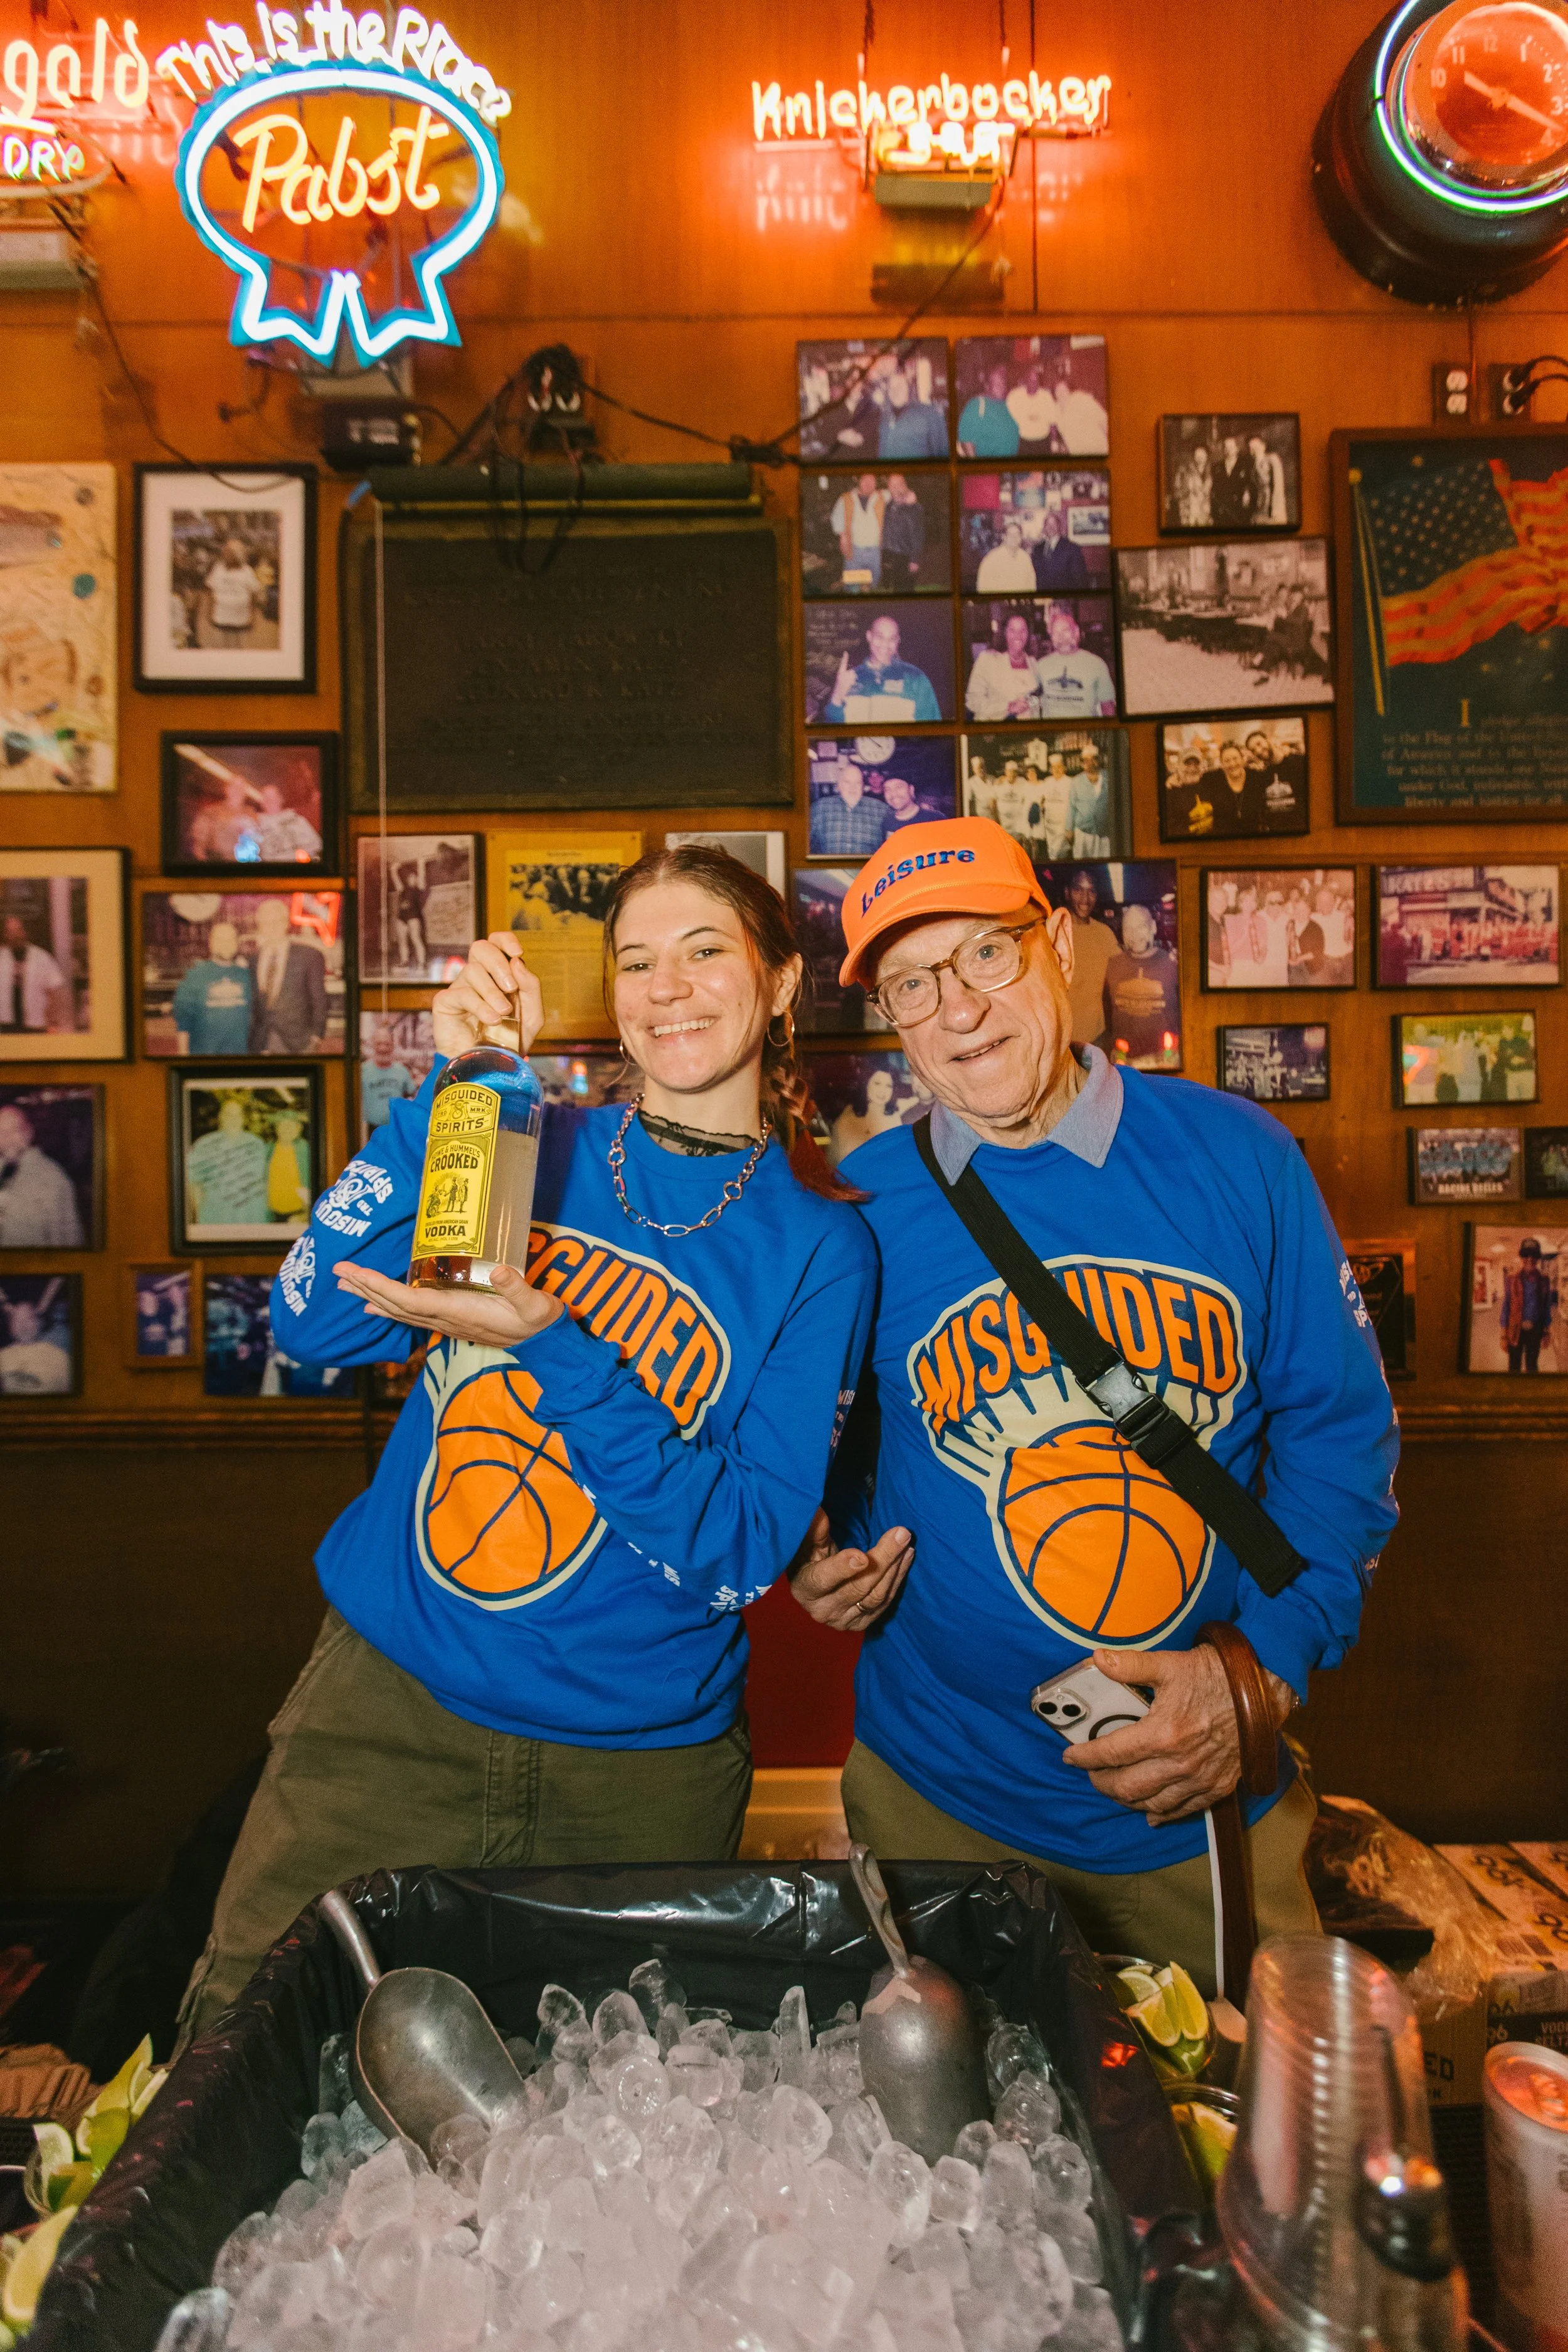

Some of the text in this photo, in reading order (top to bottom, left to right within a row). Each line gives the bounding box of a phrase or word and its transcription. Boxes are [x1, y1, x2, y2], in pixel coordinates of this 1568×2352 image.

[1431, 68, 1447, 88] 10
[1543, 63, 1554, 84] 2
[1550, 95, 1563, 115] 3
[233, 106, 450, 233] Pabst
[861, 849, 975, 918] Leisure
[437, 1089, 492, 1109] MISGUIDED
[436, 1118, 484, 1133] SPIRITS
[450, 1145, 481, 1158] HUMMEL'S
[430, 1153, 479, 1173] CROOKED
[356, 1199, 374, 1217] TRD
[425, 1225, 466, 1238] VODKA
[528, 1227, 719, 1426] GUIDED
